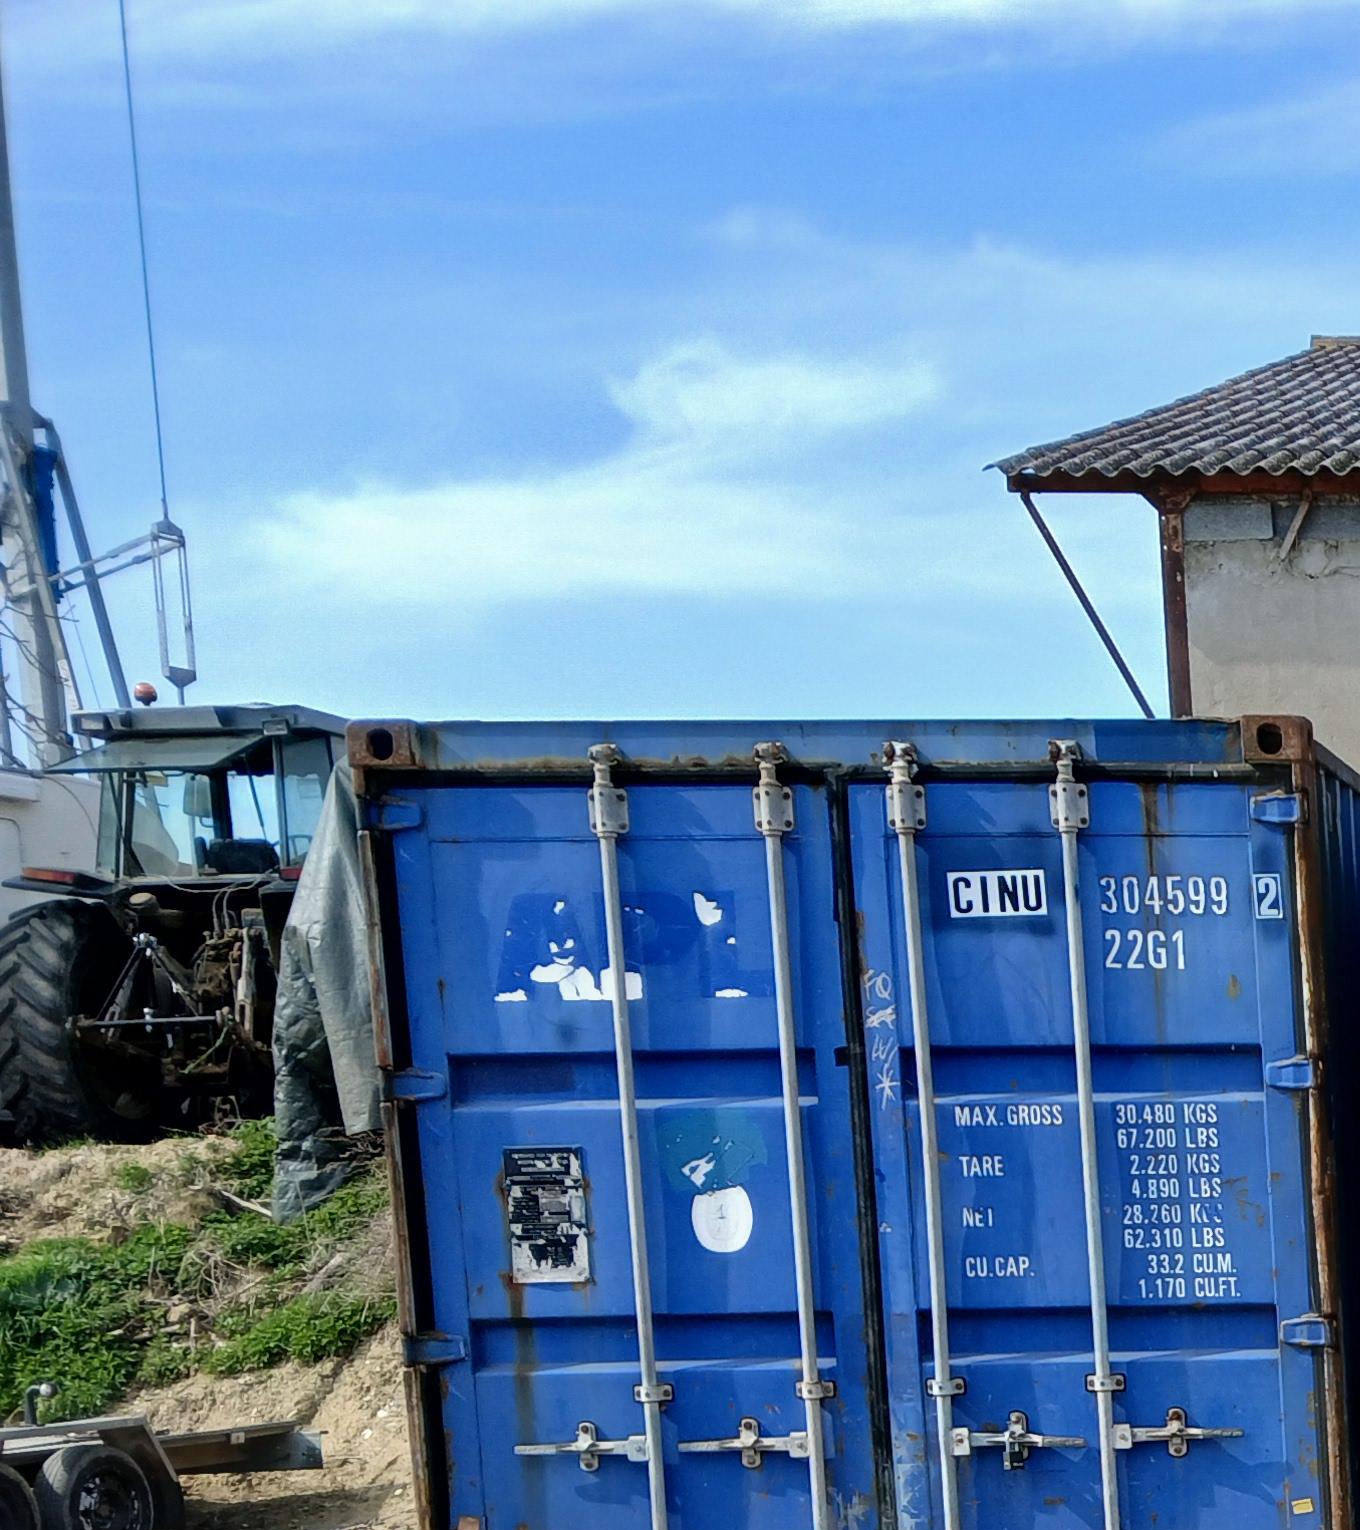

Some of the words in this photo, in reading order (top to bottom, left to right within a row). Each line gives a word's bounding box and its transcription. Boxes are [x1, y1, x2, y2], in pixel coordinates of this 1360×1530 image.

[952, 874, 1043, 914] CINU
[1100, 875, 1228, 915] 304599
[1256, 876, 1280, 917] 2
[1104, 929, 1186, 970] 22G1
[1115, 1104, 1175, 1125] 30.480
[1183, 1103, 1218, 1125] KGS
[1116, 1128, 1177, 1149] 67.200
[1185, 1128, 1219, 1148] LBS
[958, 1156, 1005, 1177] TARE
[1130, 1155, 1178, 1176] 2.220
[1186, 1154, 1221, 1174] KGS
[1131, 1178, 1180, 1199] 4.890
[1188, 1178, 1222, 1198] LBS
[1122, 1204, 1182, 1225] 28.260
[1123, 1228, 1183, 1249] 62.310
[1190, 1228, 1225, 1248] LBS
[1147, 1254, 1185, 1274] 33.2
[1192, 1253, 1238, 1273] CU.M.
[1138, 1278, 1186, 1299] 1.170
